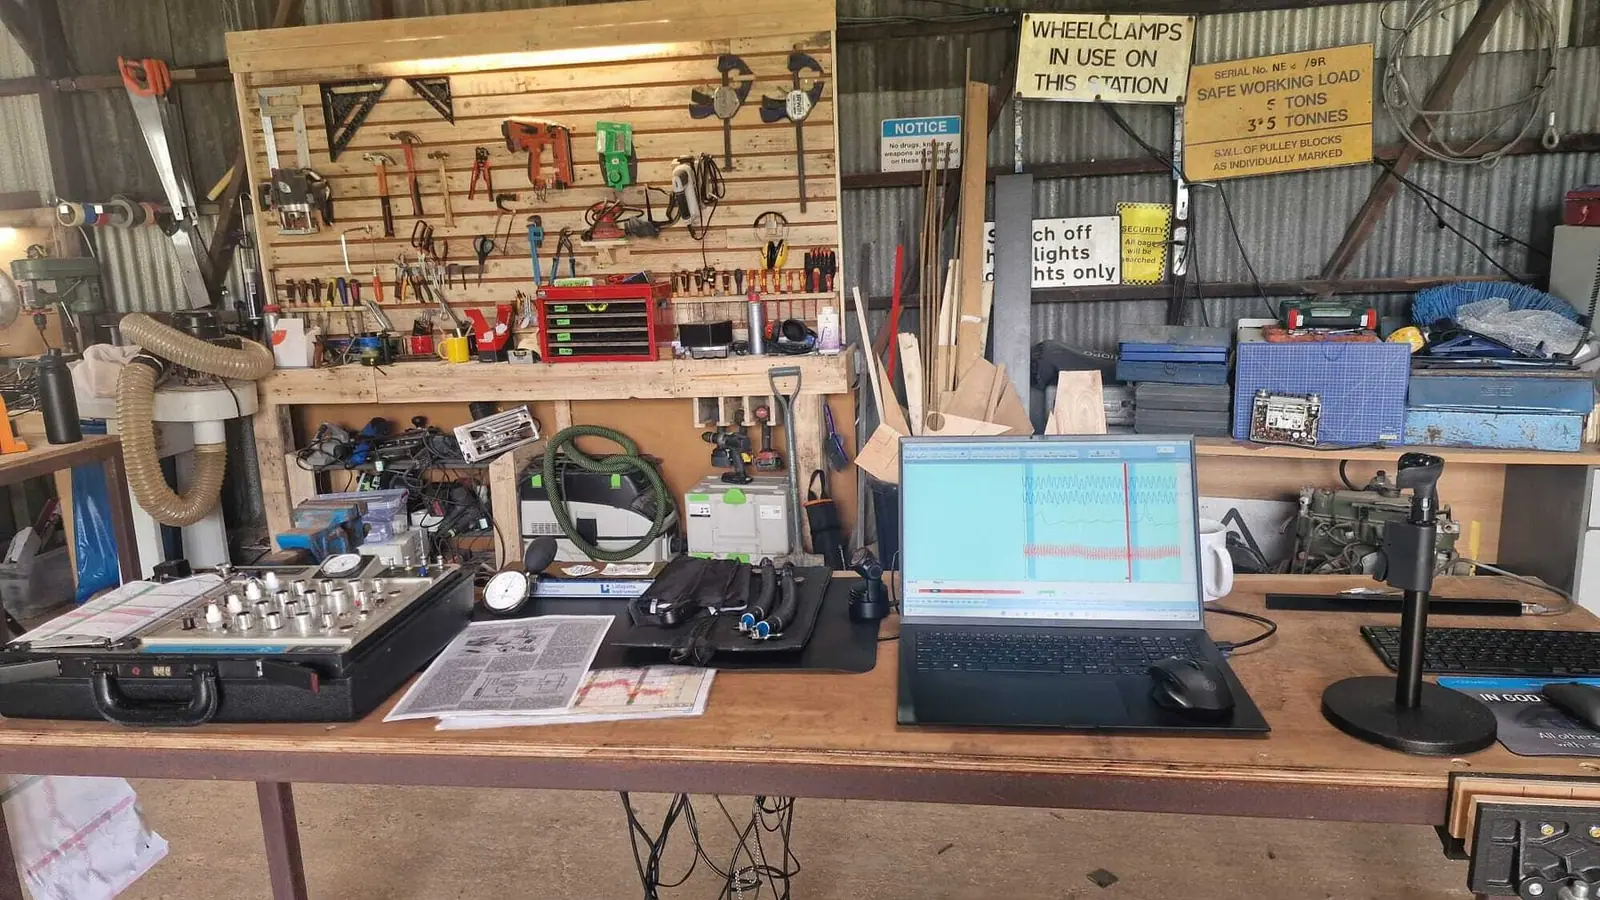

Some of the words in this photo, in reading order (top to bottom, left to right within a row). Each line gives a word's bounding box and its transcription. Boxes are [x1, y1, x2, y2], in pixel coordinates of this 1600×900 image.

[1032, 20, 1183, 42] WHEELCLAMPS
[1049, 47, 1069, 66] IN
[1077, 48, 1117, 67] USE
[1125, 49, 1158, 68] ON
[1034, 73, 1077, 92] THIS
[1214, 68, 1250, 80] SERIAL
[1197, 84, 1237, 101] SAFE
[1240, 74, 1314, 97] WORKING
[1318, 69, 1361, 87] LOAD
[1284, 92, 1328, 110] TONS
[894, 120, 948, 135] NOTICE
[1284, 108, 1349, 129] TONNES
[1243, 145, 1259, 154] OF
[1260, 140, 1298, 153] PULLEY
[1299, 134, 1343, 148] BLOCKS
[1213, 162, 1228, 172] AS
[1229, 154, 1297, 170] INDIVIDUALLY
[1298, 148, 1343, 162] MARKED
[1064, 224, 1093, 240] off
[1121, 225, 1165, 234] SECURITY
[1142, 247, 1152, 255] be
[1073, 263, 1116, 282] only
[1479, 693, 1501, 702] IN
[1501, 692, 1542, 703] GOD
[1538, 731, 1556, 740] All
